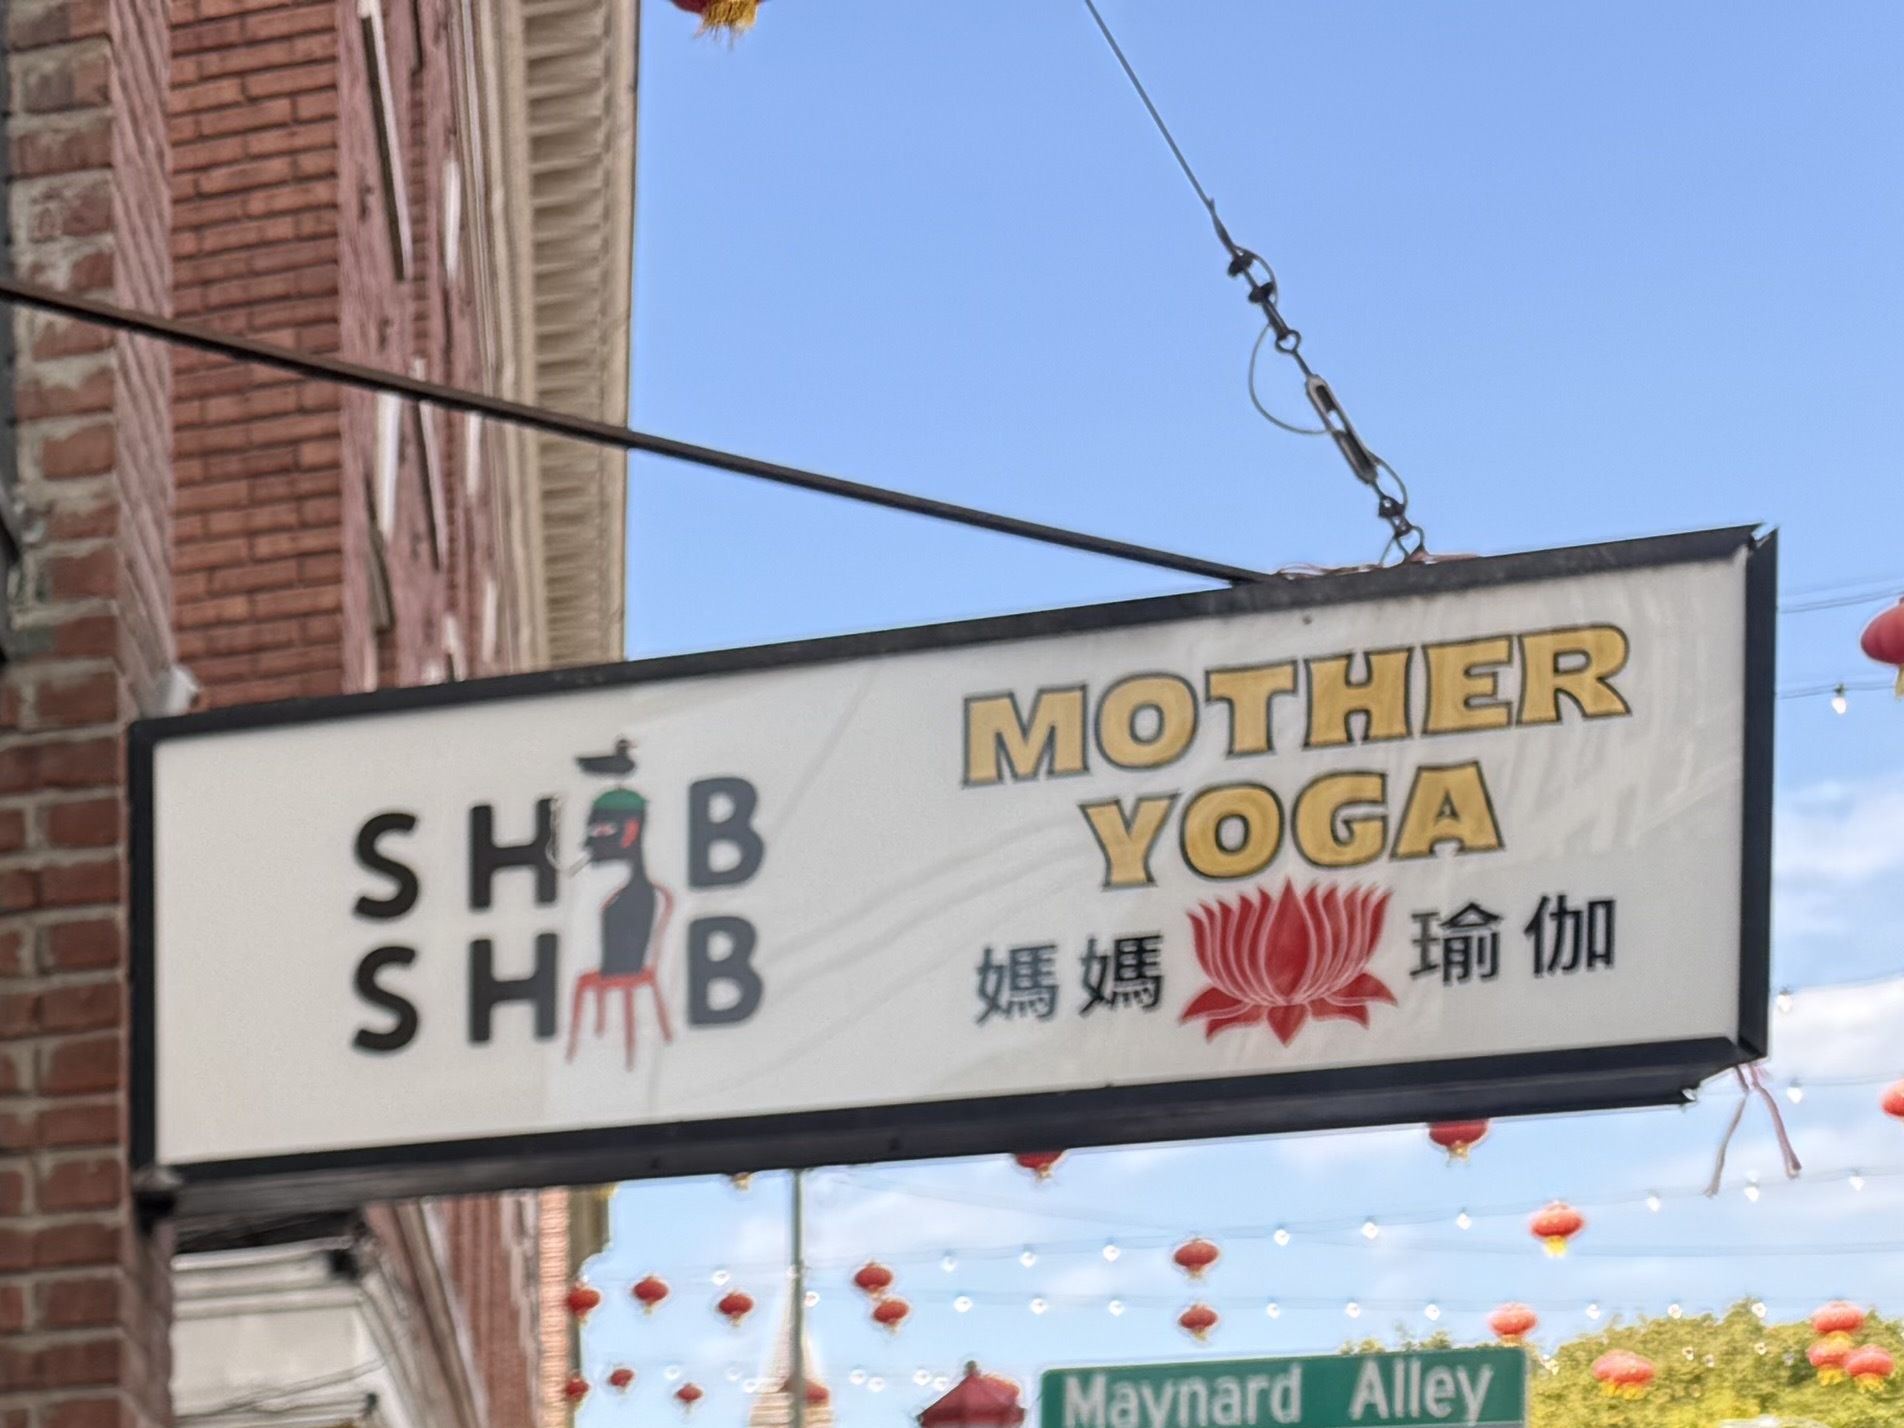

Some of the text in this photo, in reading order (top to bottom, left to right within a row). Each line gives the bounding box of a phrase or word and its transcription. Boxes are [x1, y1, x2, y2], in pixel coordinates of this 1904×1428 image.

[960, 621, 1633, 788] MOTHER
[1080, 758, 1503, 890] YOGA
[974, 893, 1618, 1026] 媽媽 瑜伽
[1350, 1356, 1494, 1427] Alley
